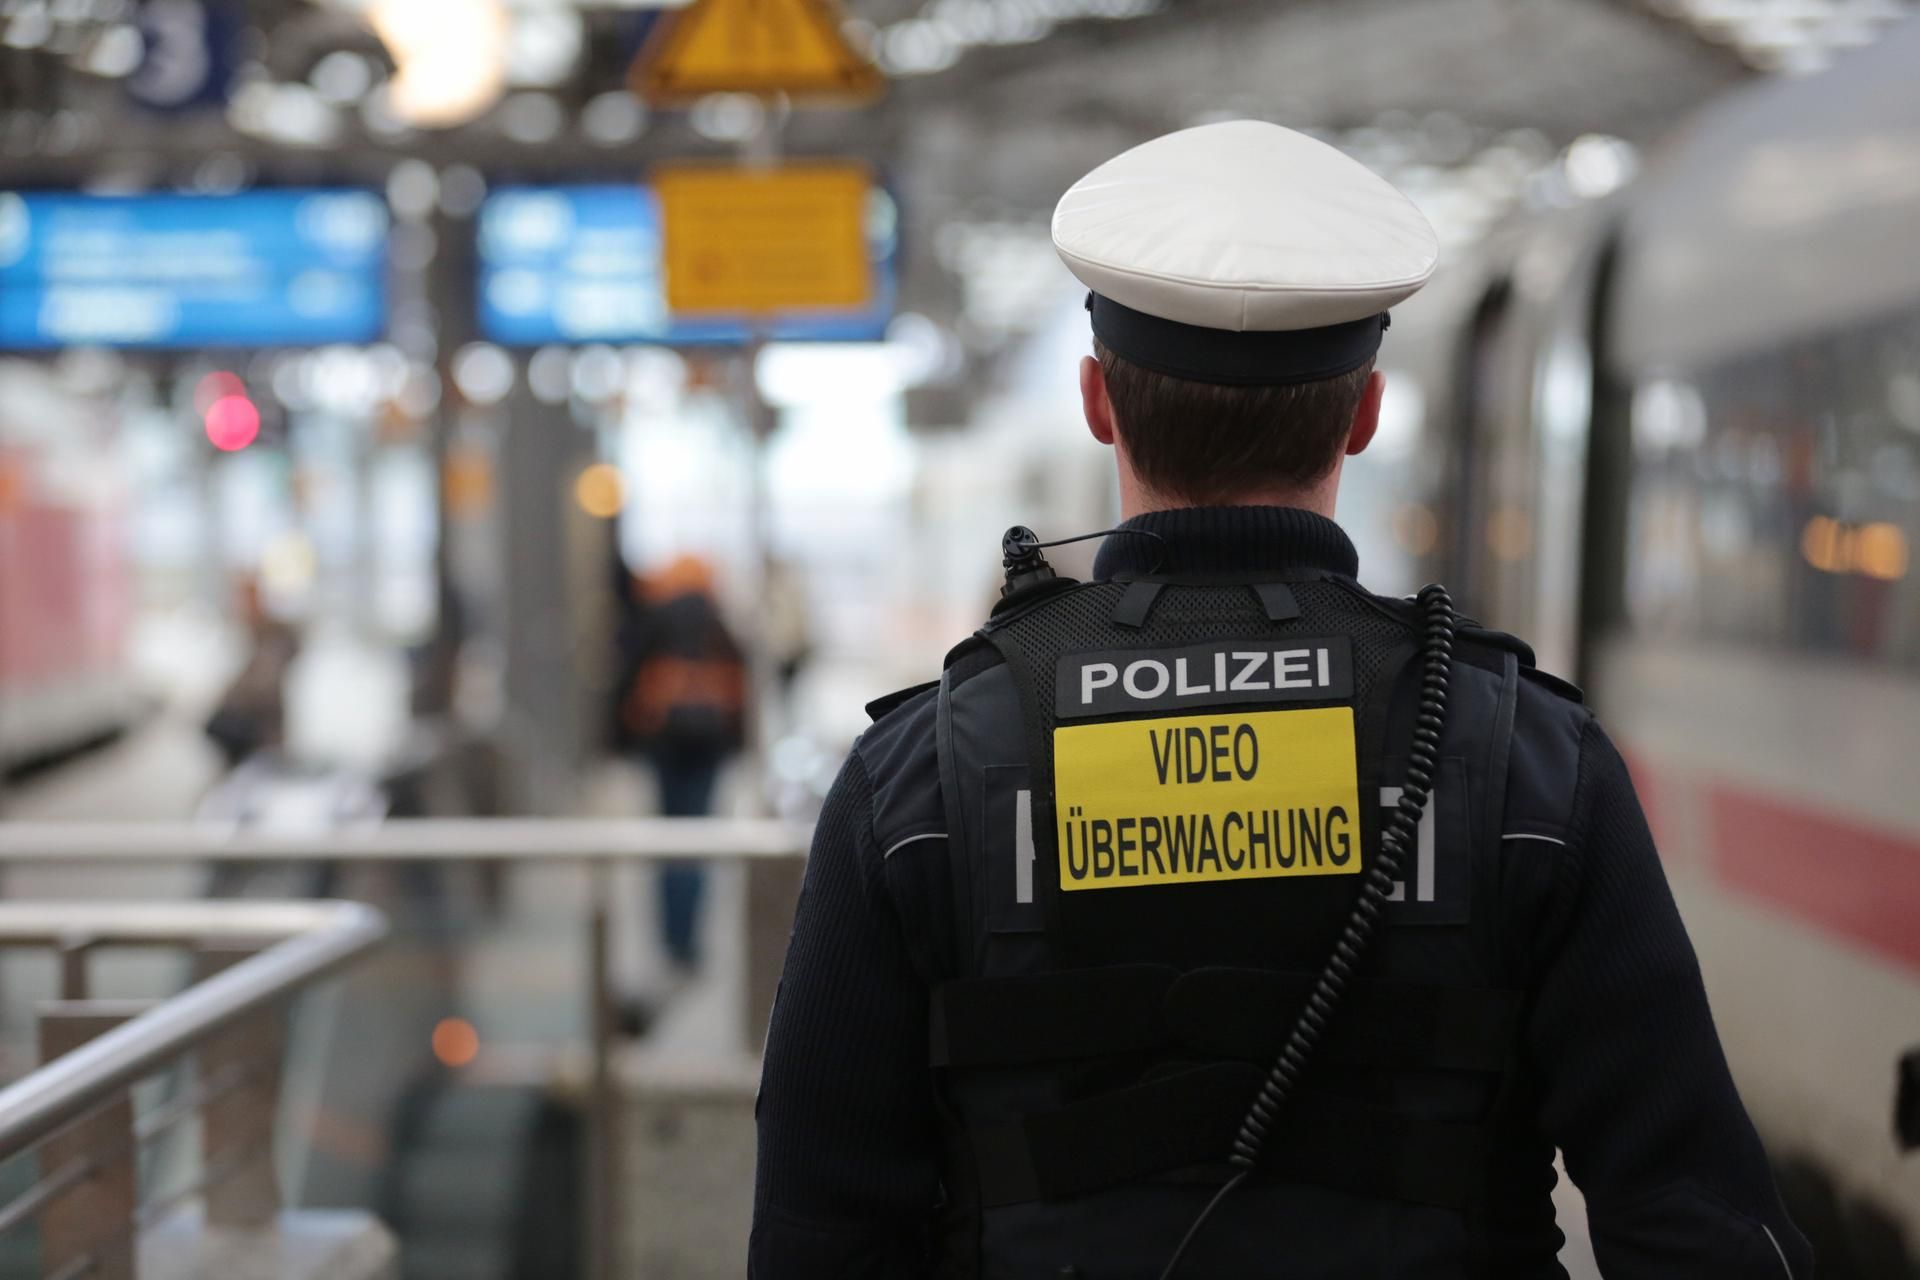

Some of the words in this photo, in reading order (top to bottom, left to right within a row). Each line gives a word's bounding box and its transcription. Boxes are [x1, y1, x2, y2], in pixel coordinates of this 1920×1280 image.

[1081, 648, 1330, 704] POLIZEI
[1149, 723, 1259, 785] VIDEO
[1066, 806, 1351, 880] ÜBERWACHUNG
